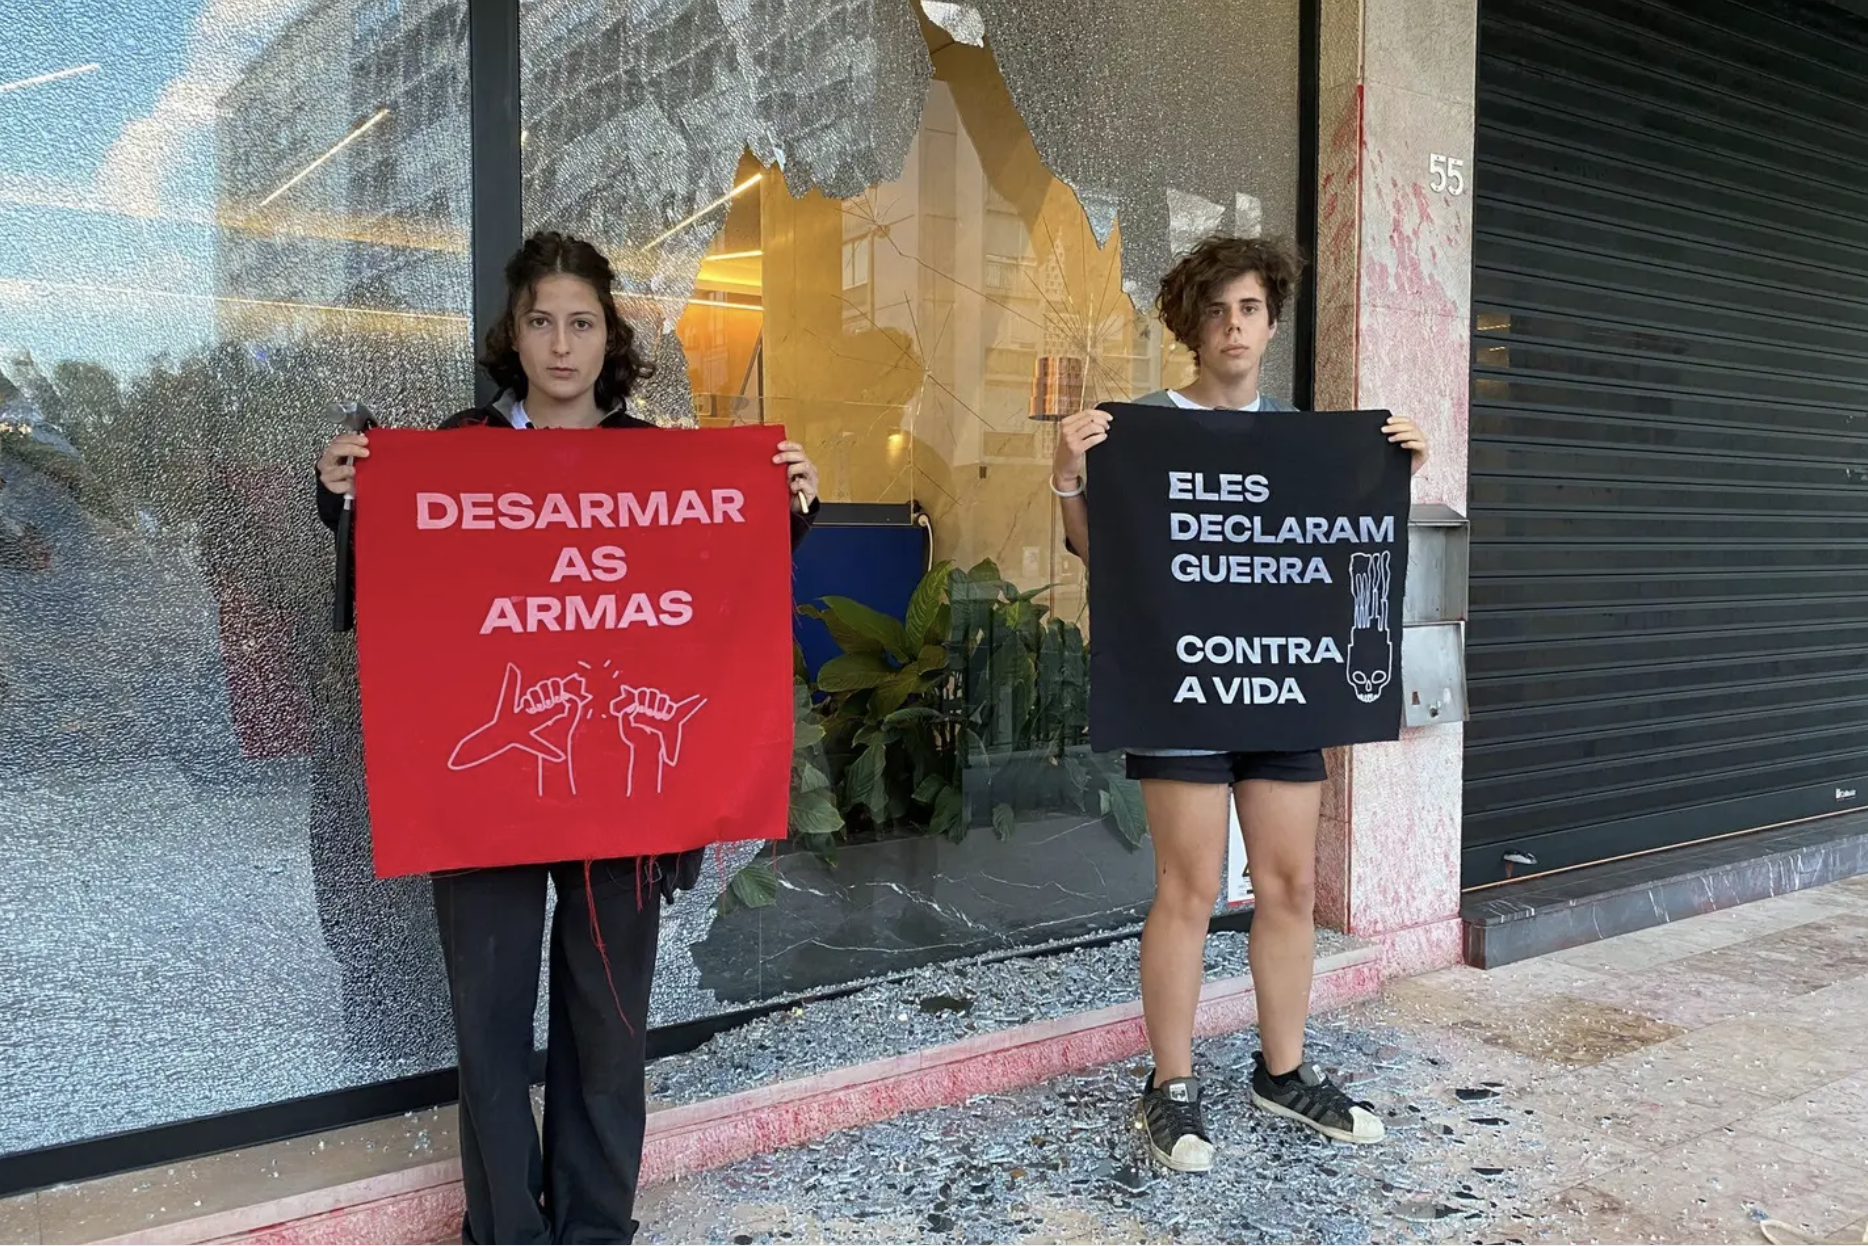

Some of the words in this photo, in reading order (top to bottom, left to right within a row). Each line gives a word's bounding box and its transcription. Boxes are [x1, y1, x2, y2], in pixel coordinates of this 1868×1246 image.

[1429, 152, 1464, 196] 55
[1168, 471, 1270, 503] ELES
[415, 488, 746, 530] DESARMAR
[1170, 512, 1395, 543] DECLARAM
[549, 545, 628, 583] AS
[1171, 553, 1333, 584] GUERRA
[479, 590, 693, 634] ARMAS
[1176, 634, 1345, 664] CONTRA
[1173, 675, 1207, 704] A
[1212, 676, 1307, 705] VIDA
